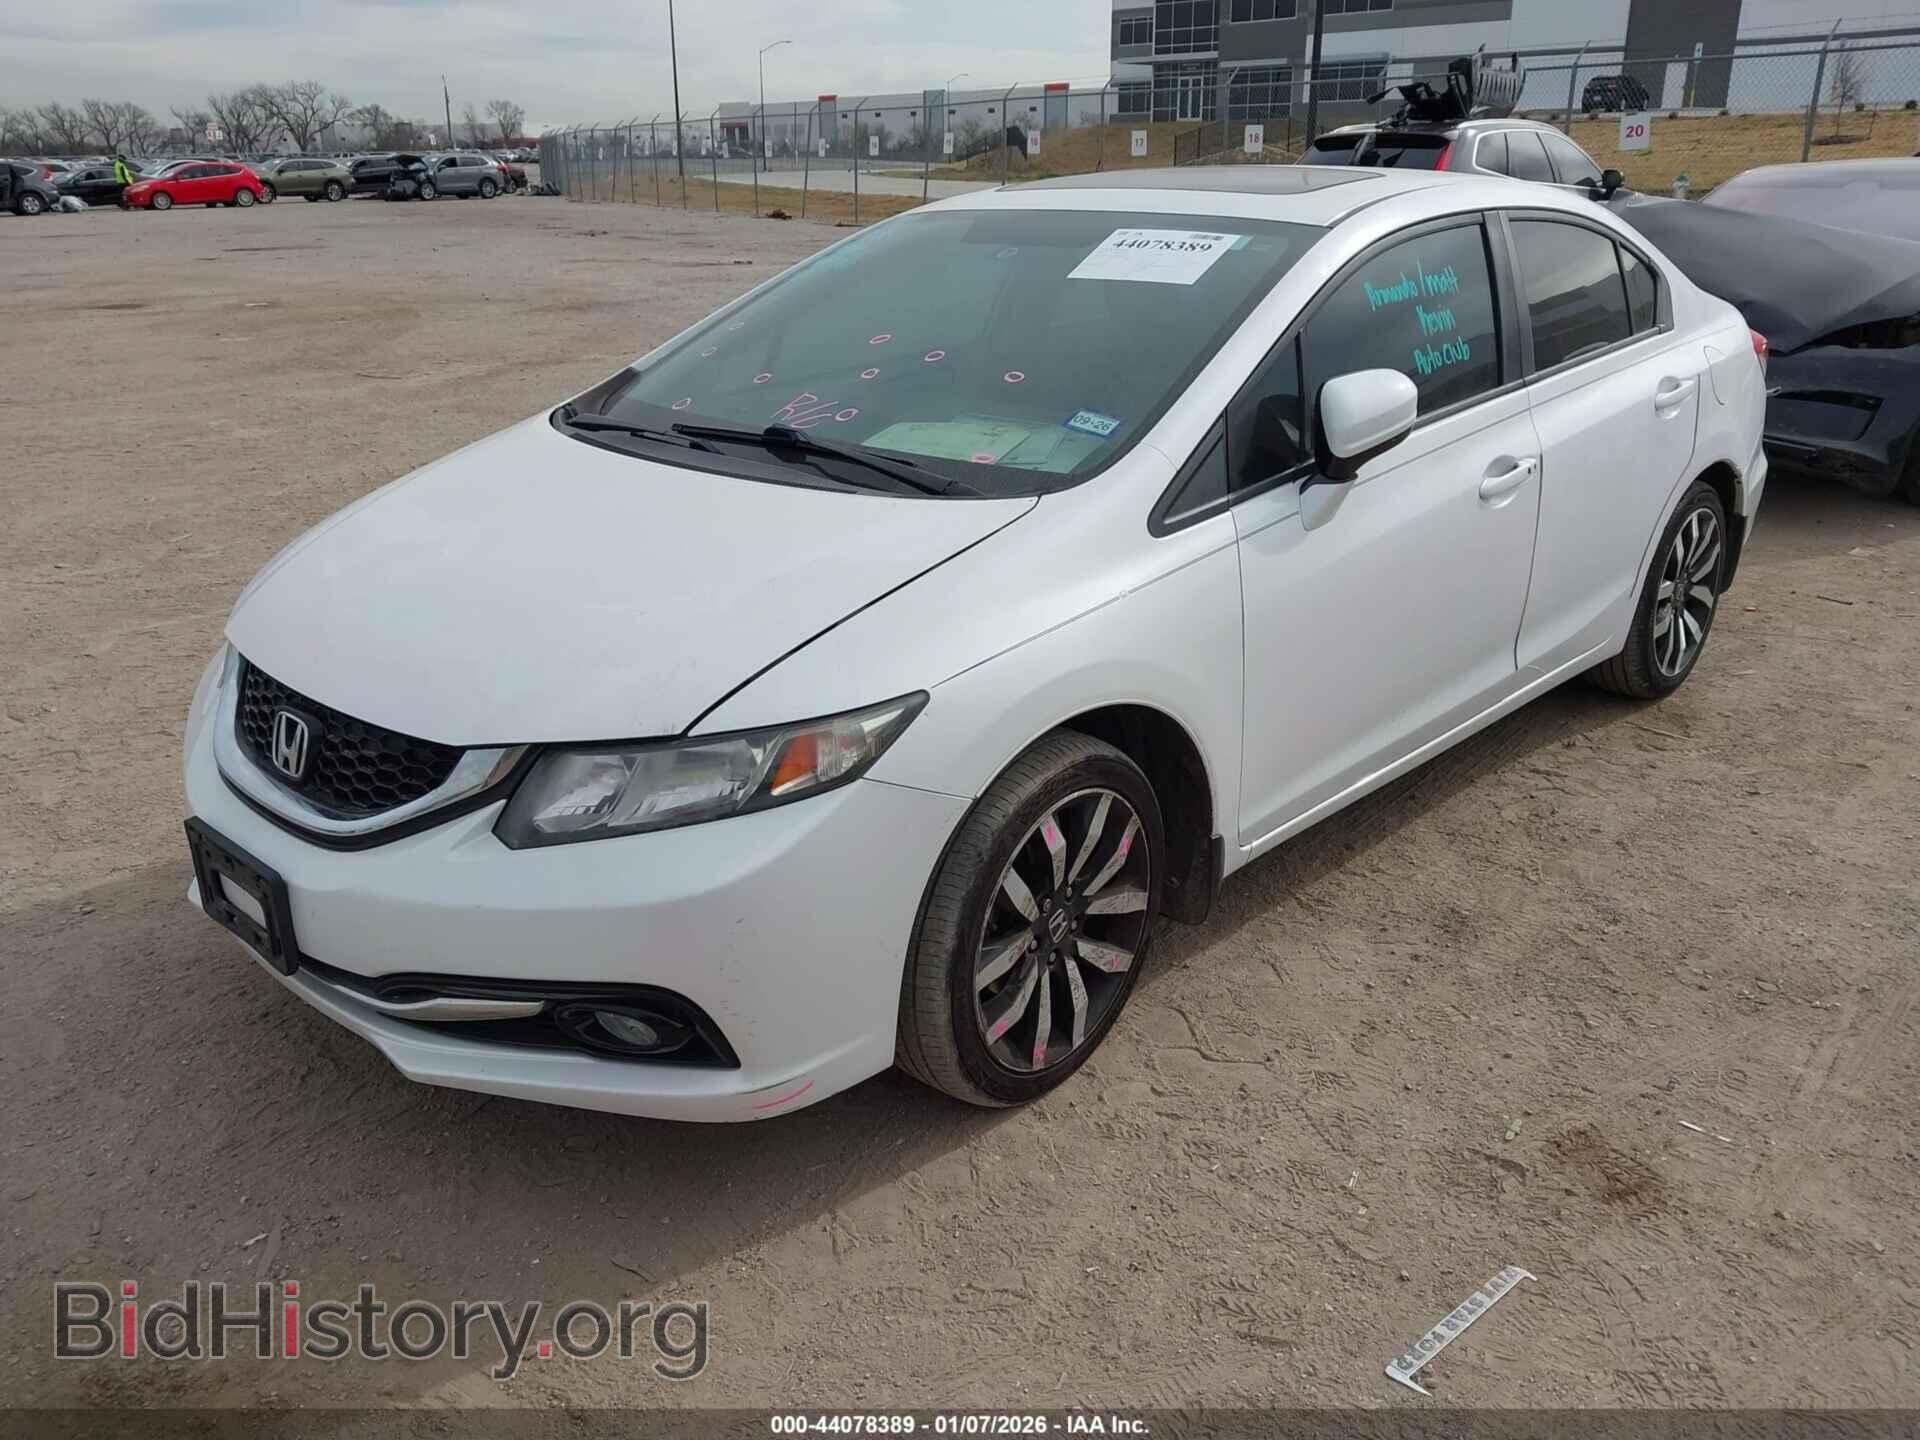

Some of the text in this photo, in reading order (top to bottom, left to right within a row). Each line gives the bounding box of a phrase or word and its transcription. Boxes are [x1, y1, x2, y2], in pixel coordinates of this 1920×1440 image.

[1625, 124, 1645, 138] 20
[1249, 132, 1260, 144] 18
[1112, 239, 1213, 252] 44078389
